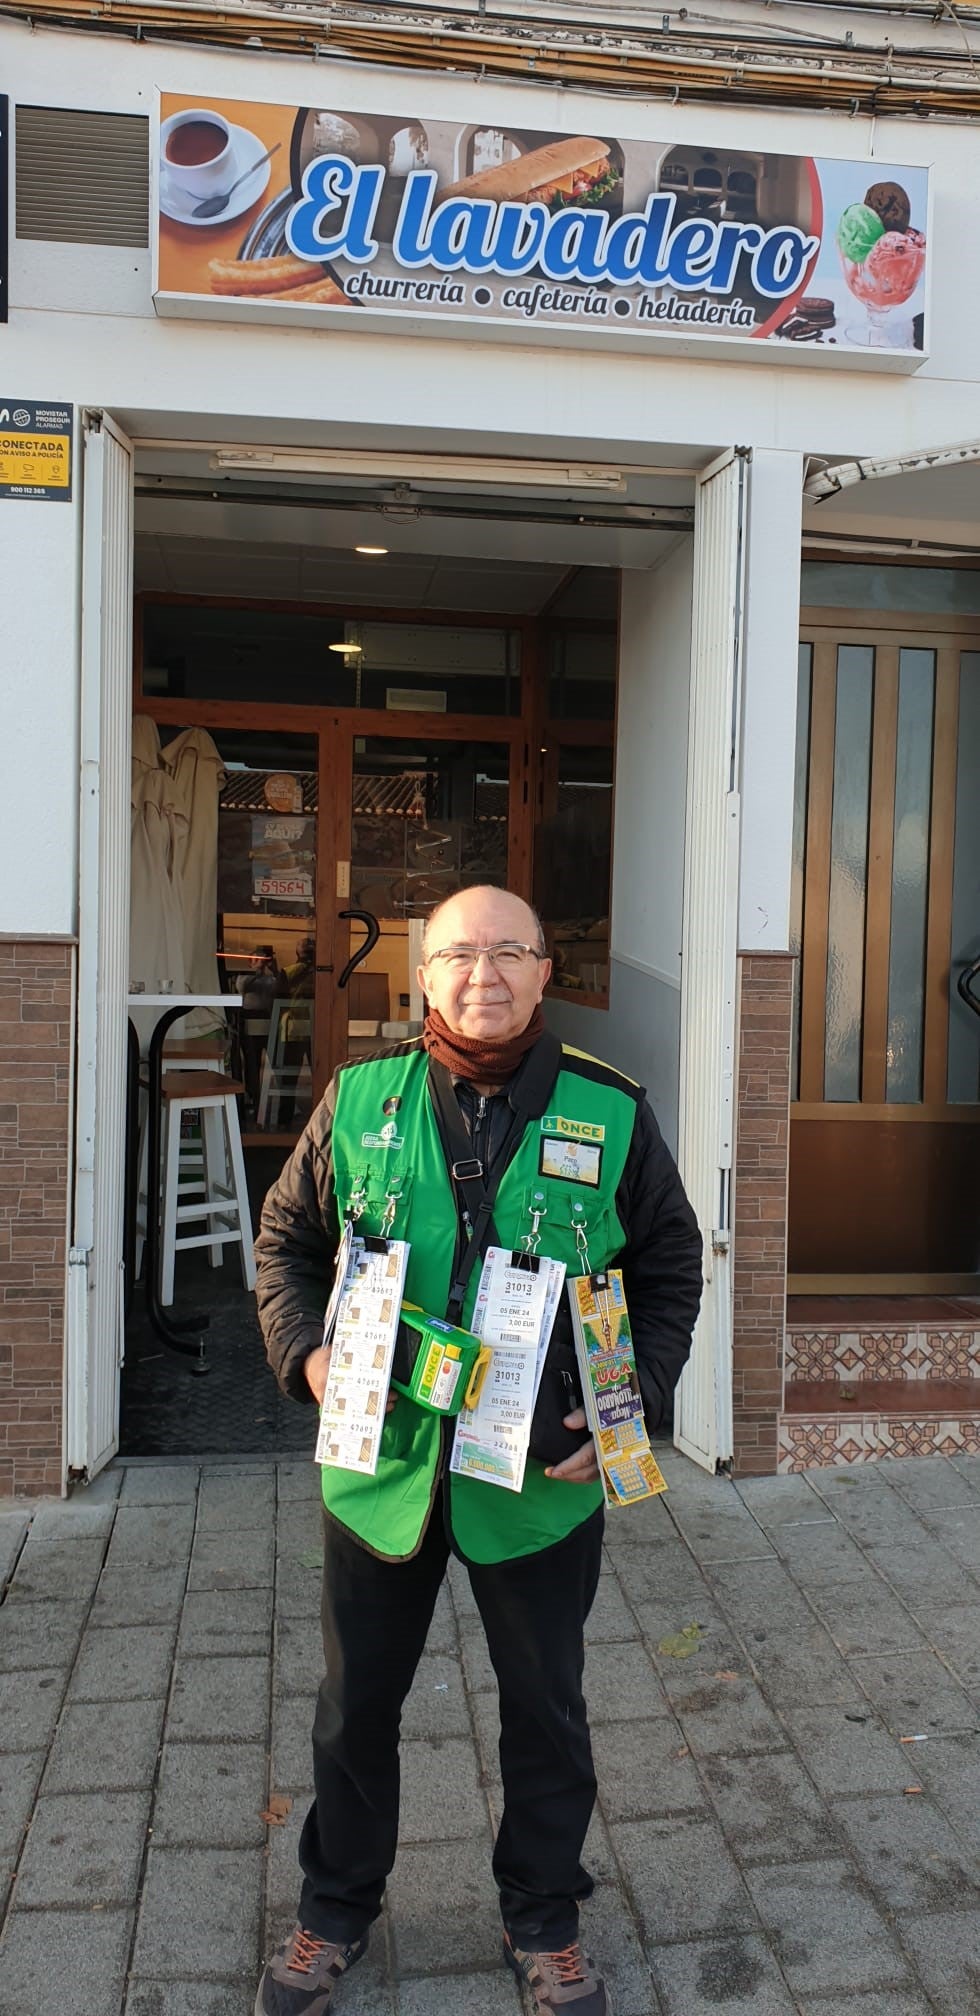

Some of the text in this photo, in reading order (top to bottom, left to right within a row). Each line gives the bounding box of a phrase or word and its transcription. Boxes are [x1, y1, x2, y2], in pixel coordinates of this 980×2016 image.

[287, 156, 818, 296] El lavadero
[346, 272, 753, 326] churrería cafetería heladería
[36, 409, 68, 417] MOVISTAR
[36, 416, 70, 424] PROSEGUR
[261, 880, 304, 894] 59564
[561, 1121, 601, 1137] ONCE
[505, 1282, 532, 1292] 31013
[424, 1346, 441, 1383] ONCE
[495, 1371, 520, 1381] 31013
